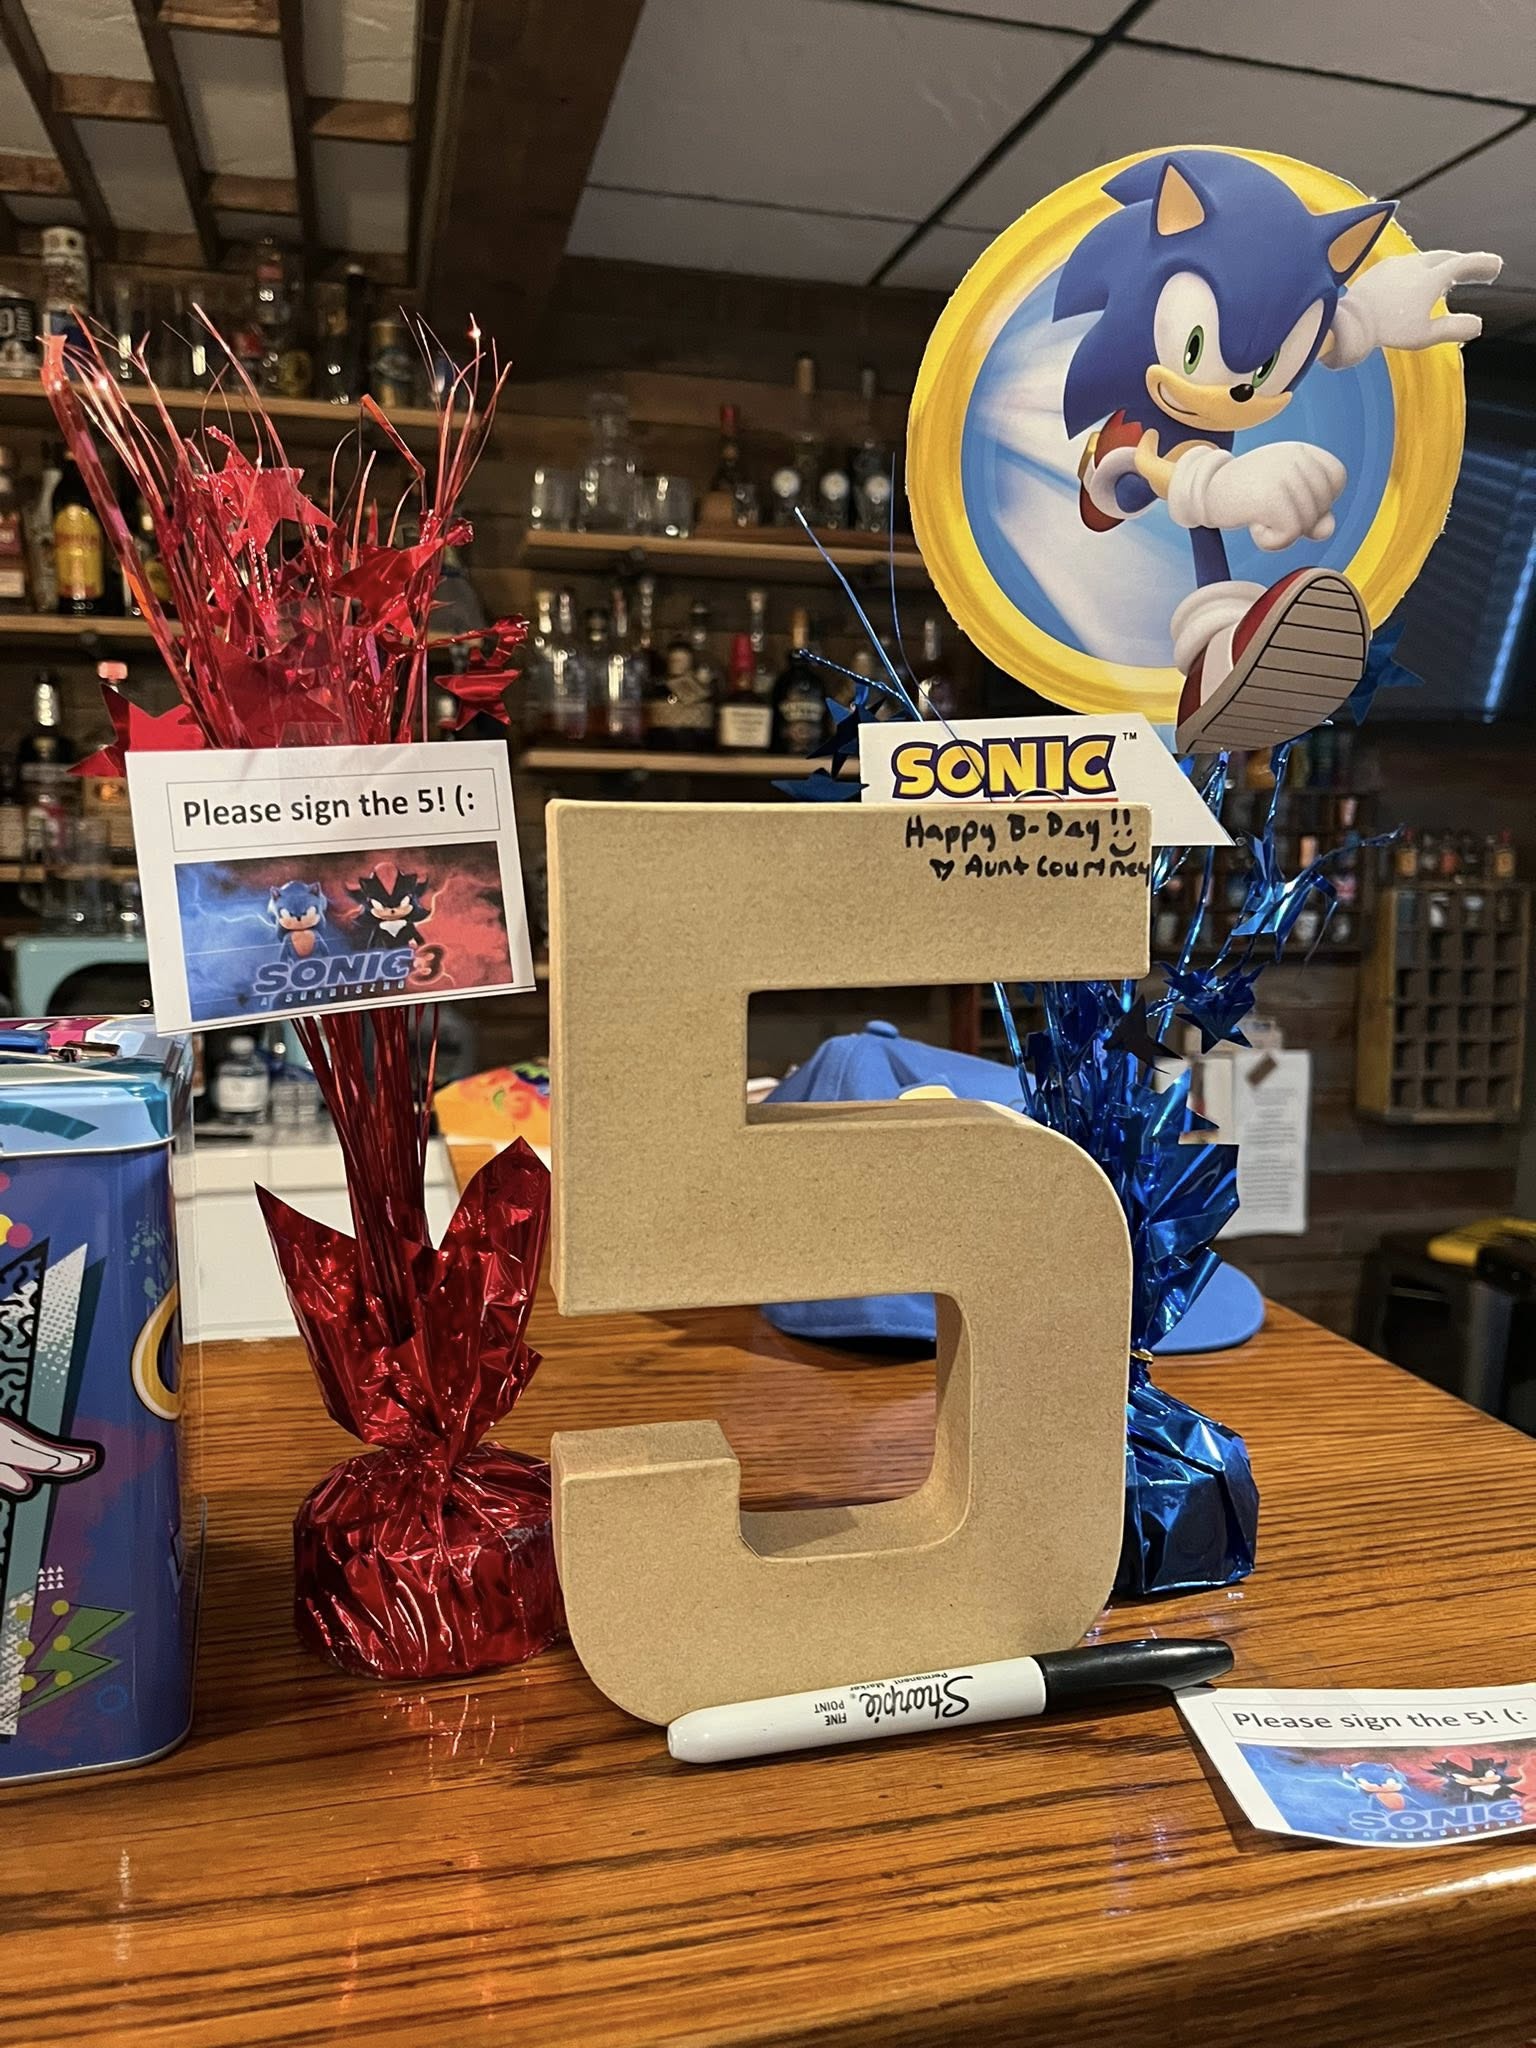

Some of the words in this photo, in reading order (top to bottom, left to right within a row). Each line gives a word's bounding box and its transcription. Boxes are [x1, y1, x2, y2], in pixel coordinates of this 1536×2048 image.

[891, 735, 1117, 799] SONIC
[183, 798, 281, 828] Please
[291, 793, 350, 825] sign
[358, 789, 409, 817] the
[417, 786, 446, 814] 5!
[905, 814, 997, 853] Happy
[965, 854, 1030, 878] Aunt
[253, 949, 414, 995] SONIC
[850, 1682, 886, 1692] Marker
[894, 1672, 949, 1685] Permanent
[814, 1700, 846, 1714] POINT
[859, 1675, 974, 1724] Sharpie
[825, 1713, 848, 1726] FINE
[1231, 1711, 1333, 1730] Please
[1340, 1711, 1401, 1732] sign
[1407, 1711, 1460, 1729] the
[1464, 1709, 1498, 1726] 5!
[1349, 1800, 1524, 1832] SONIC
